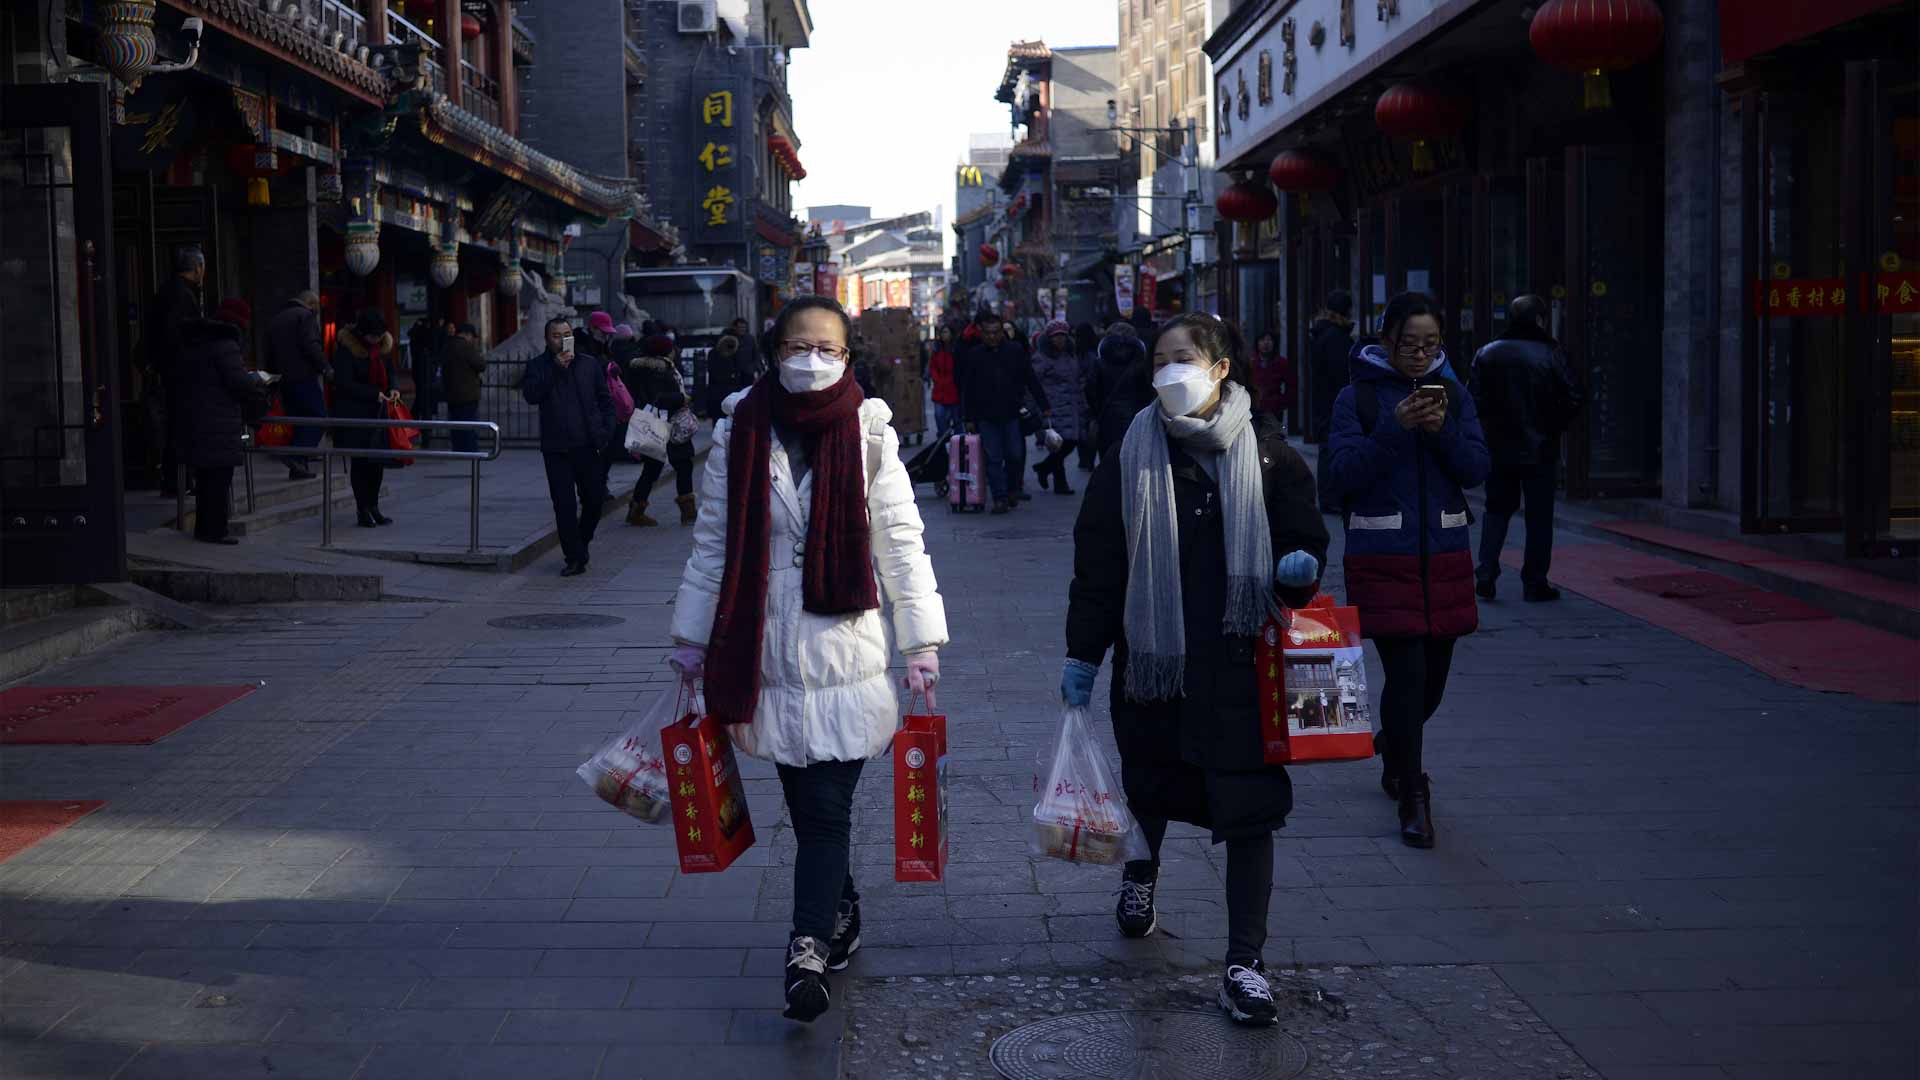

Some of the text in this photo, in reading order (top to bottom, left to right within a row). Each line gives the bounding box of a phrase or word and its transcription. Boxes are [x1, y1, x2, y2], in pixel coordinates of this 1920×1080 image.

[698, 90, 734, 227] 同仁堂
[906, 784, 926, 849] 稻香村
